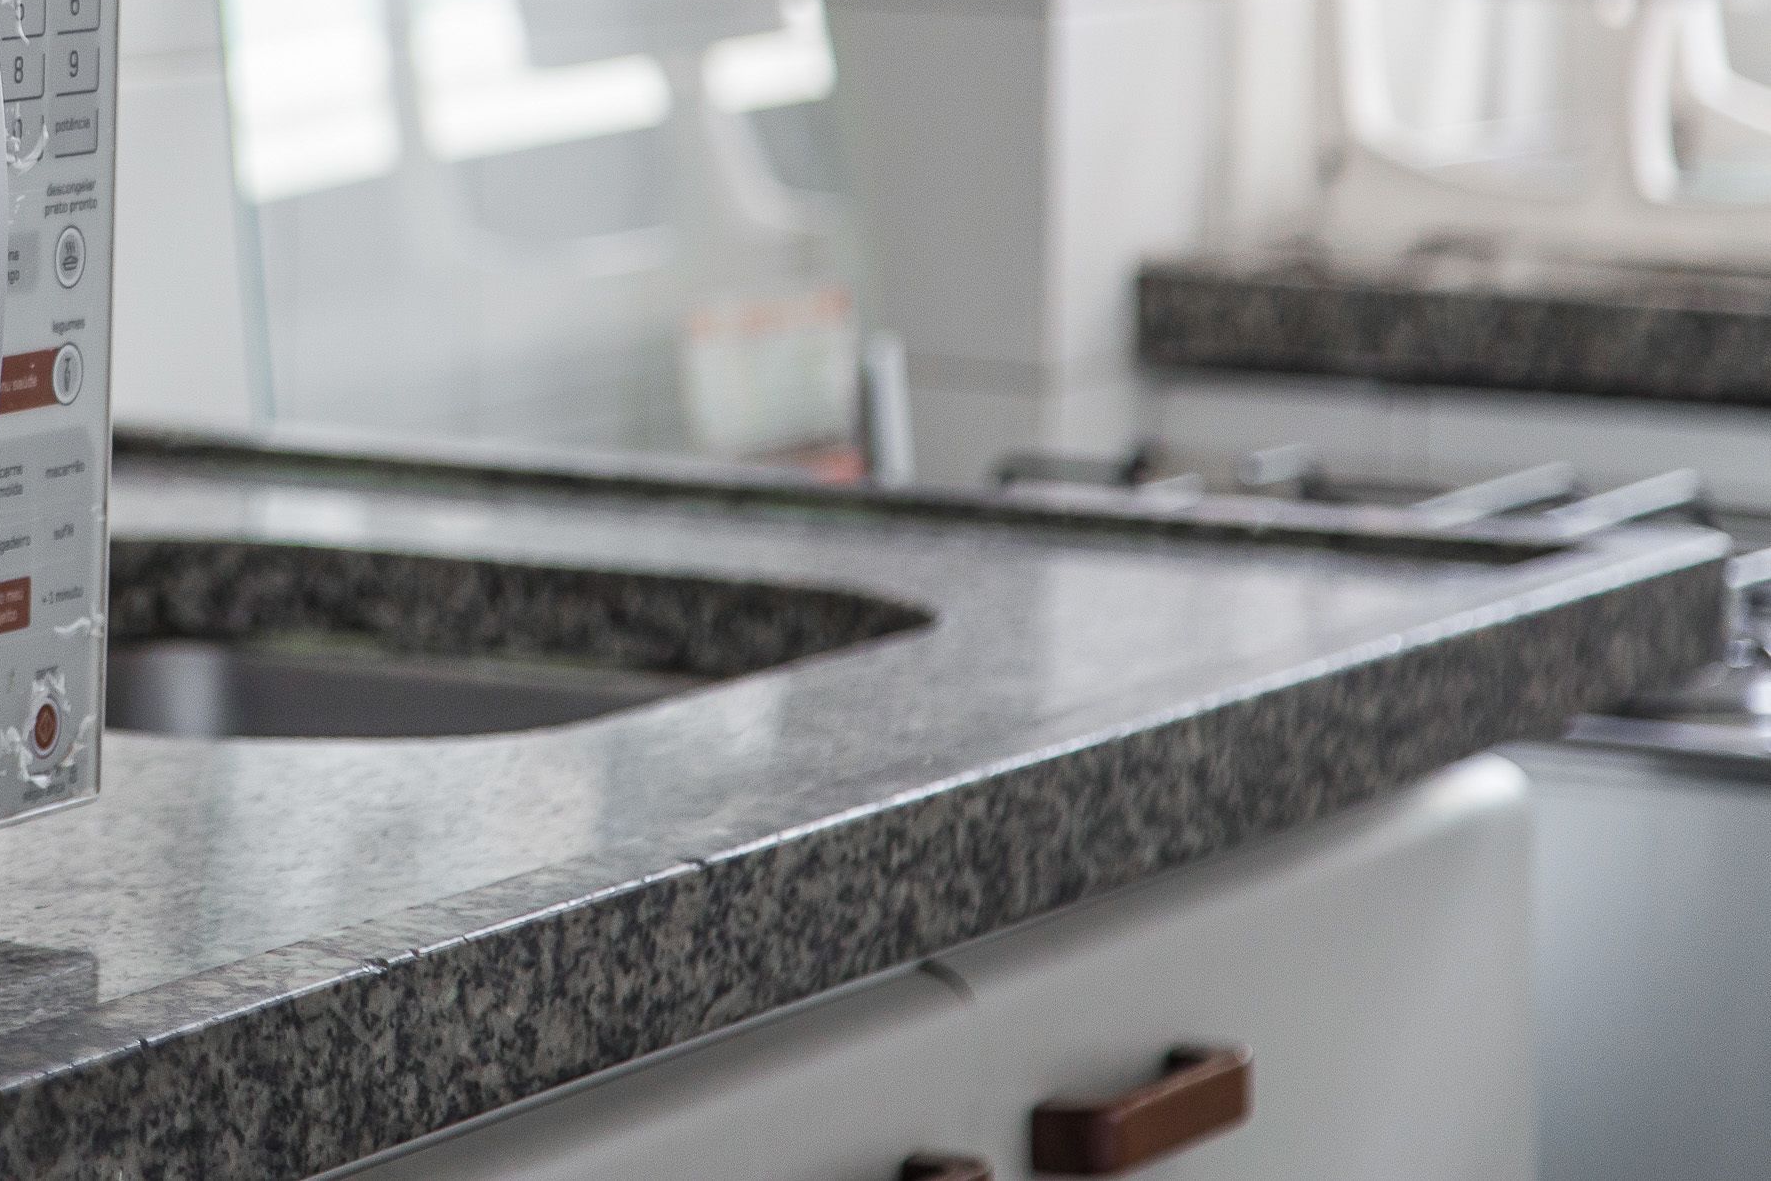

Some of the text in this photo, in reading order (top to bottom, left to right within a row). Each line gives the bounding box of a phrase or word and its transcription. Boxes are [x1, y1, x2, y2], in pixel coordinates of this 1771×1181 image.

[14, 49, 79, 84] 8 9
[44, 198, 98, 219] prato pronto
